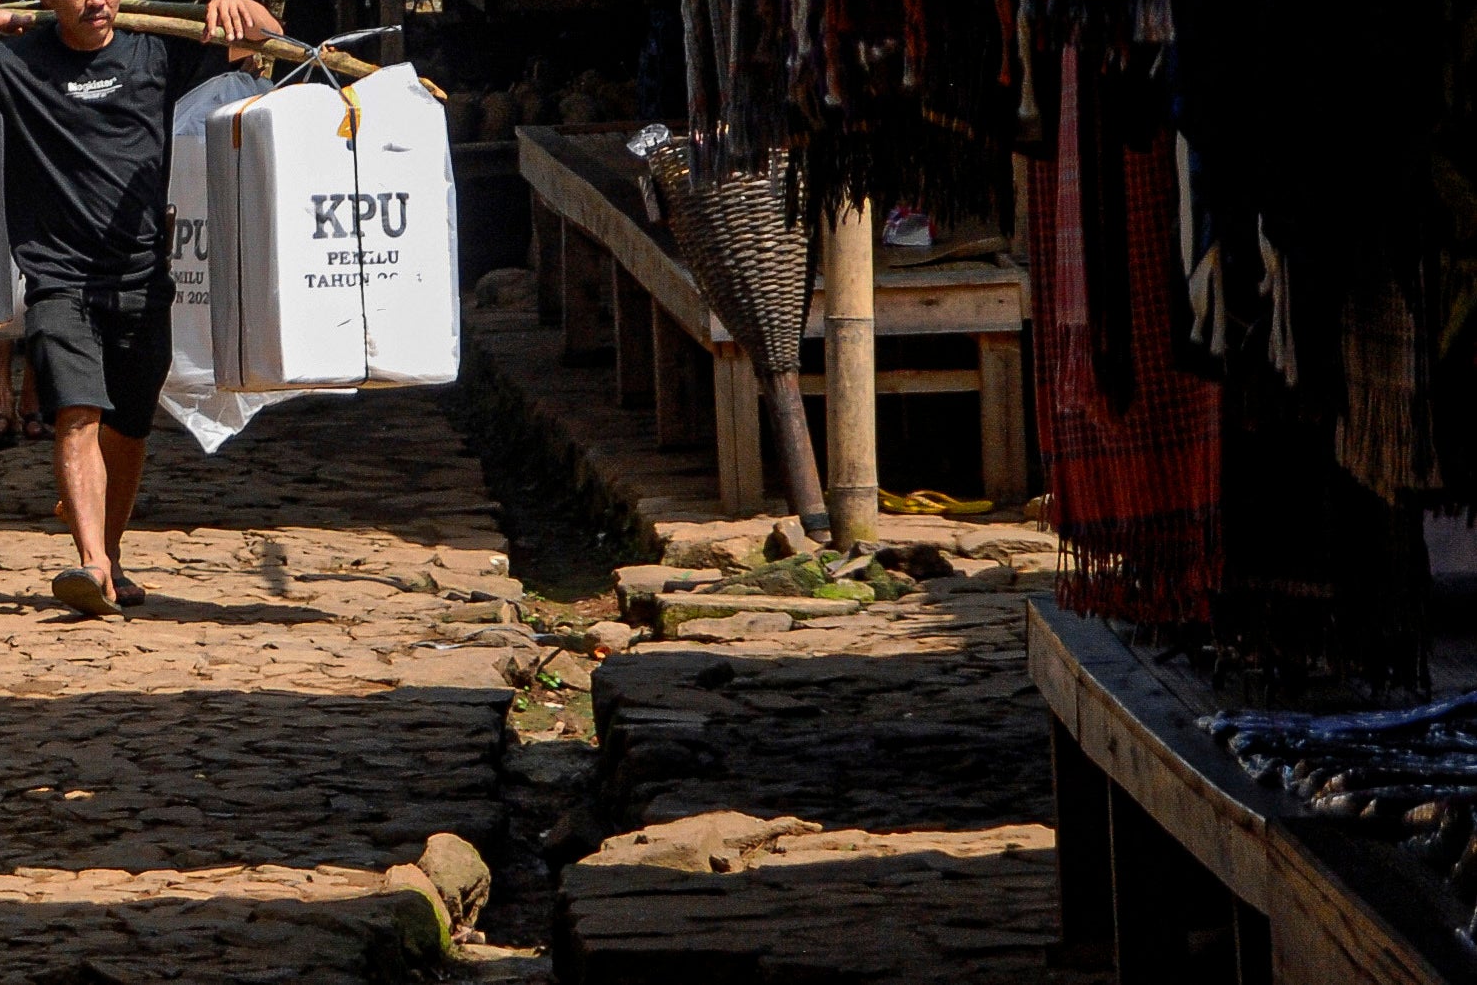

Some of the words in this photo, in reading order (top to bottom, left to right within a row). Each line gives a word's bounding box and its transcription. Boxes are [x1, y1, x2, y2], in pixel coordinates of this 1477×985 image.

[310, 192, 409, 239] KPU
[175, 219, 209, 261] PU
[187, 291, 210, 305] 202
